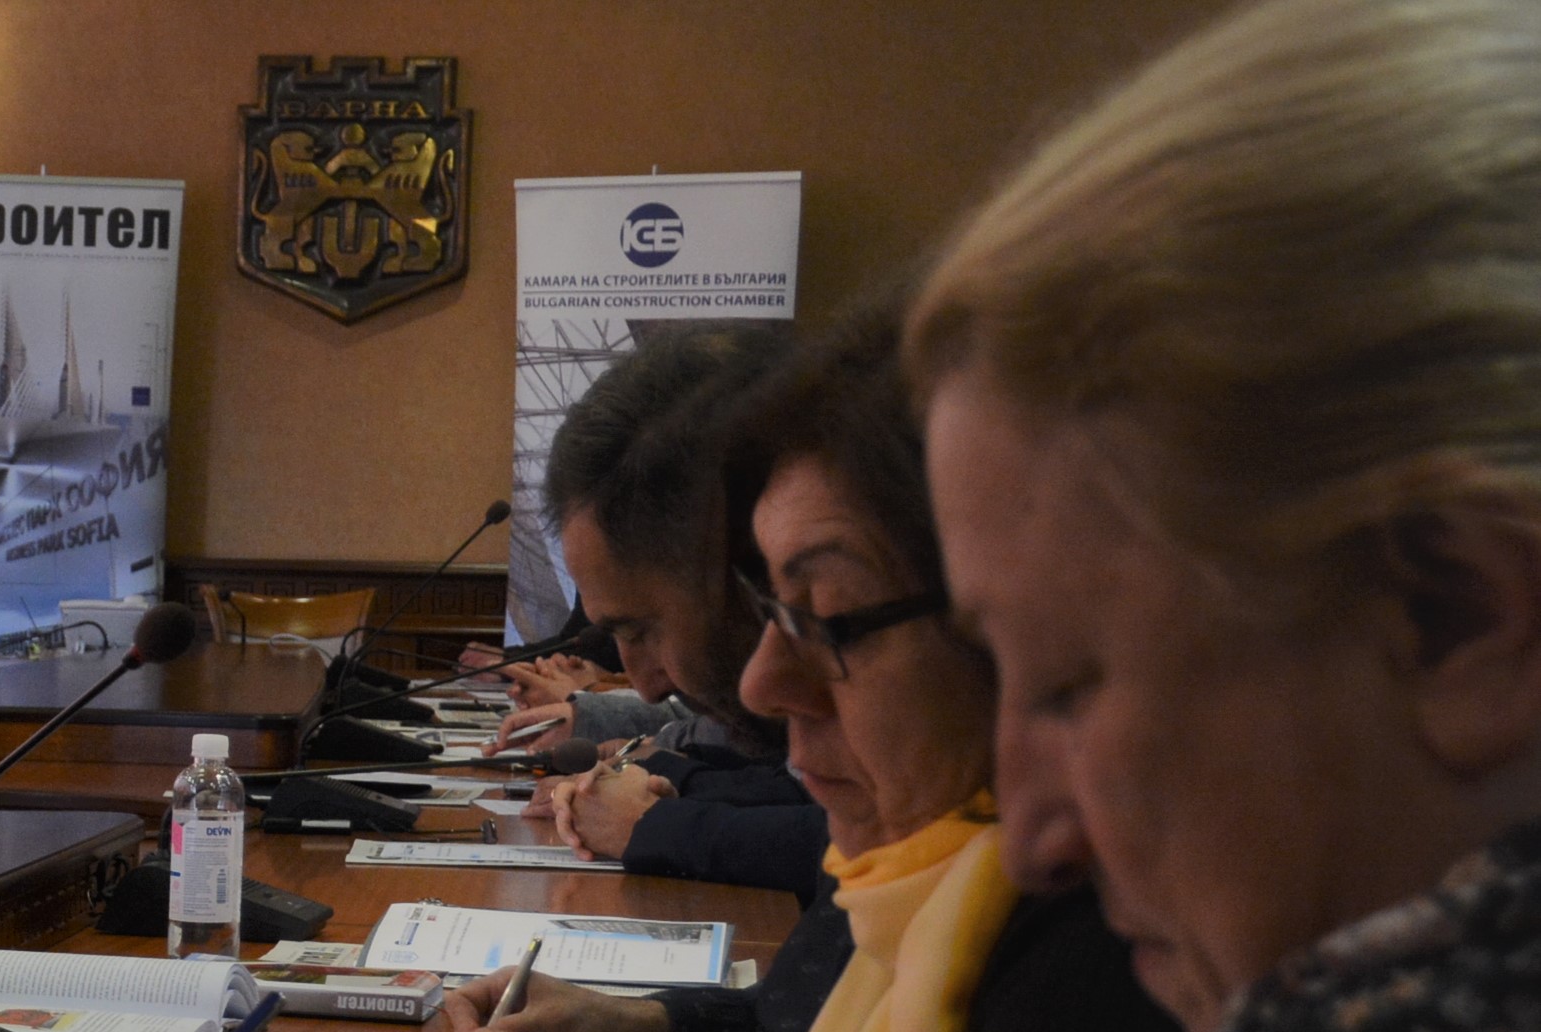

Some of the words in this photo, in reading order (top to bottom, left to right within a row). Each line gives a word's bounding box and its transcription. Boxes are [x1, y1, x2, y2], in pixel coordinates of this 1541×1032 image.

[524, 275, 577, 288] КАМАРА
[581, 275, 599, 287] НА
[603, 273, 699, 287] СТРОИТЕЛИТЕ
[702, 273, 711, 286] В
[713, 272, 787, 286] БЪЛГАРИЯ
[524, 296, 601, 309] BULGARIAN
[604, 295, 712, 308] CONSTRUCTION
[714, 294, 786, 307] CHAMBER
[67, 512, 120, 549] SOFIA
[206, 826, 232, 836] DEVIN
